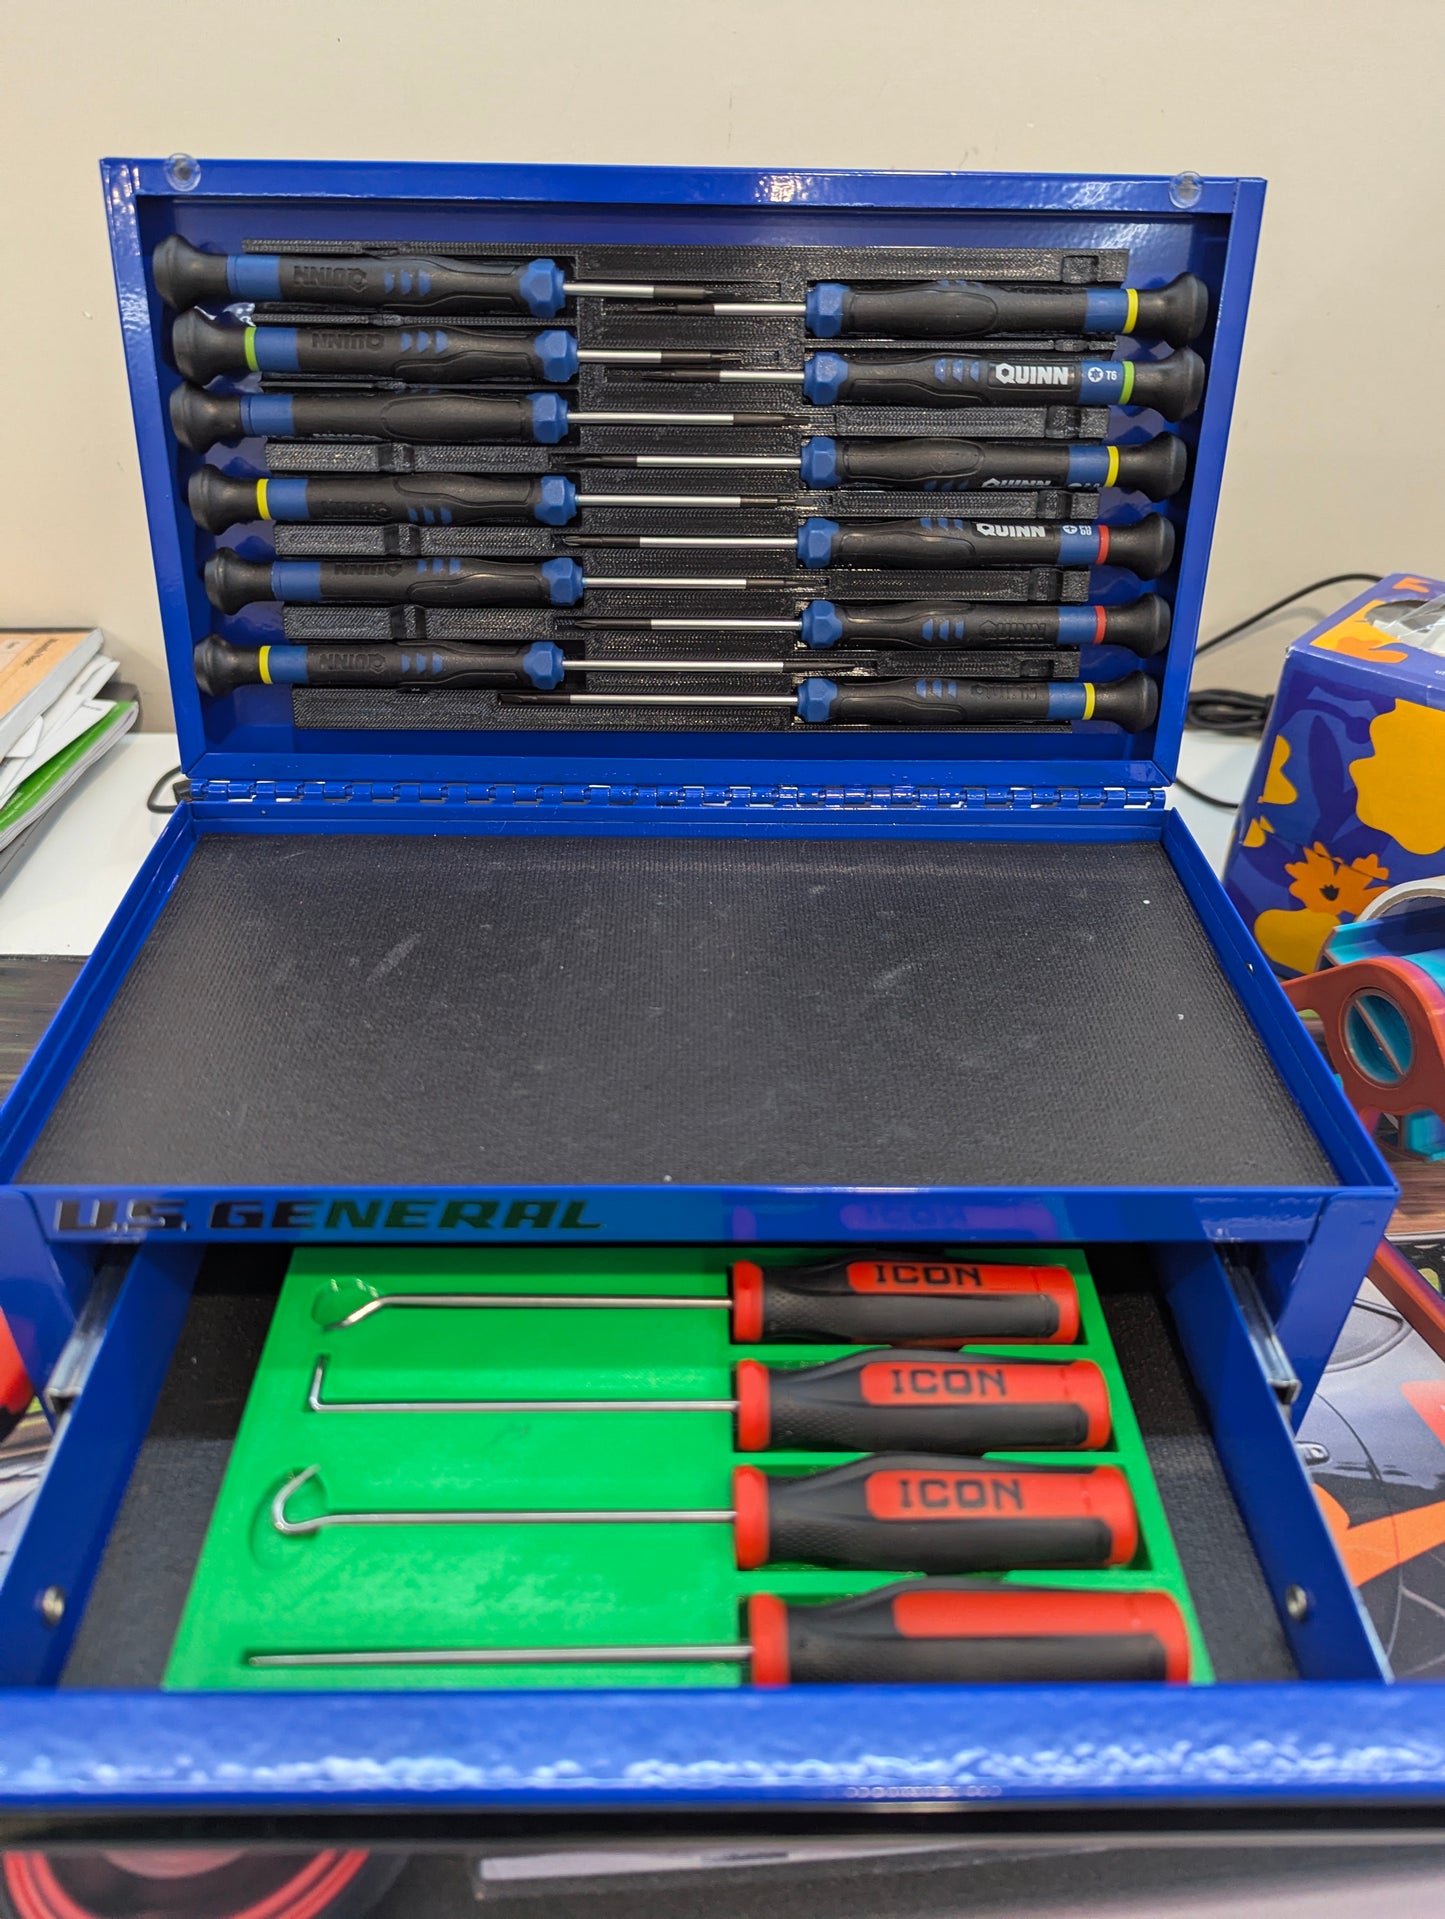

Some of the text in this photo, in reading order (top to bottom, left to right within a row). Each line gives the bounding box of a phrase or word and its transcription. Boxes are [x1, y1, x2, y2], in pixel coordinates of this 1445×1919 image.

[995, 362, 1117, 386] QUINN T6
[976, 523, 1046, 537] QUINN
[208, 1199, 603, 1230] GENERAL
[875, 1263, 984, 1288] ICON
[891, 1368, 1007, 1397] ICON
[899, 1477, 1026, 1511] ICON
